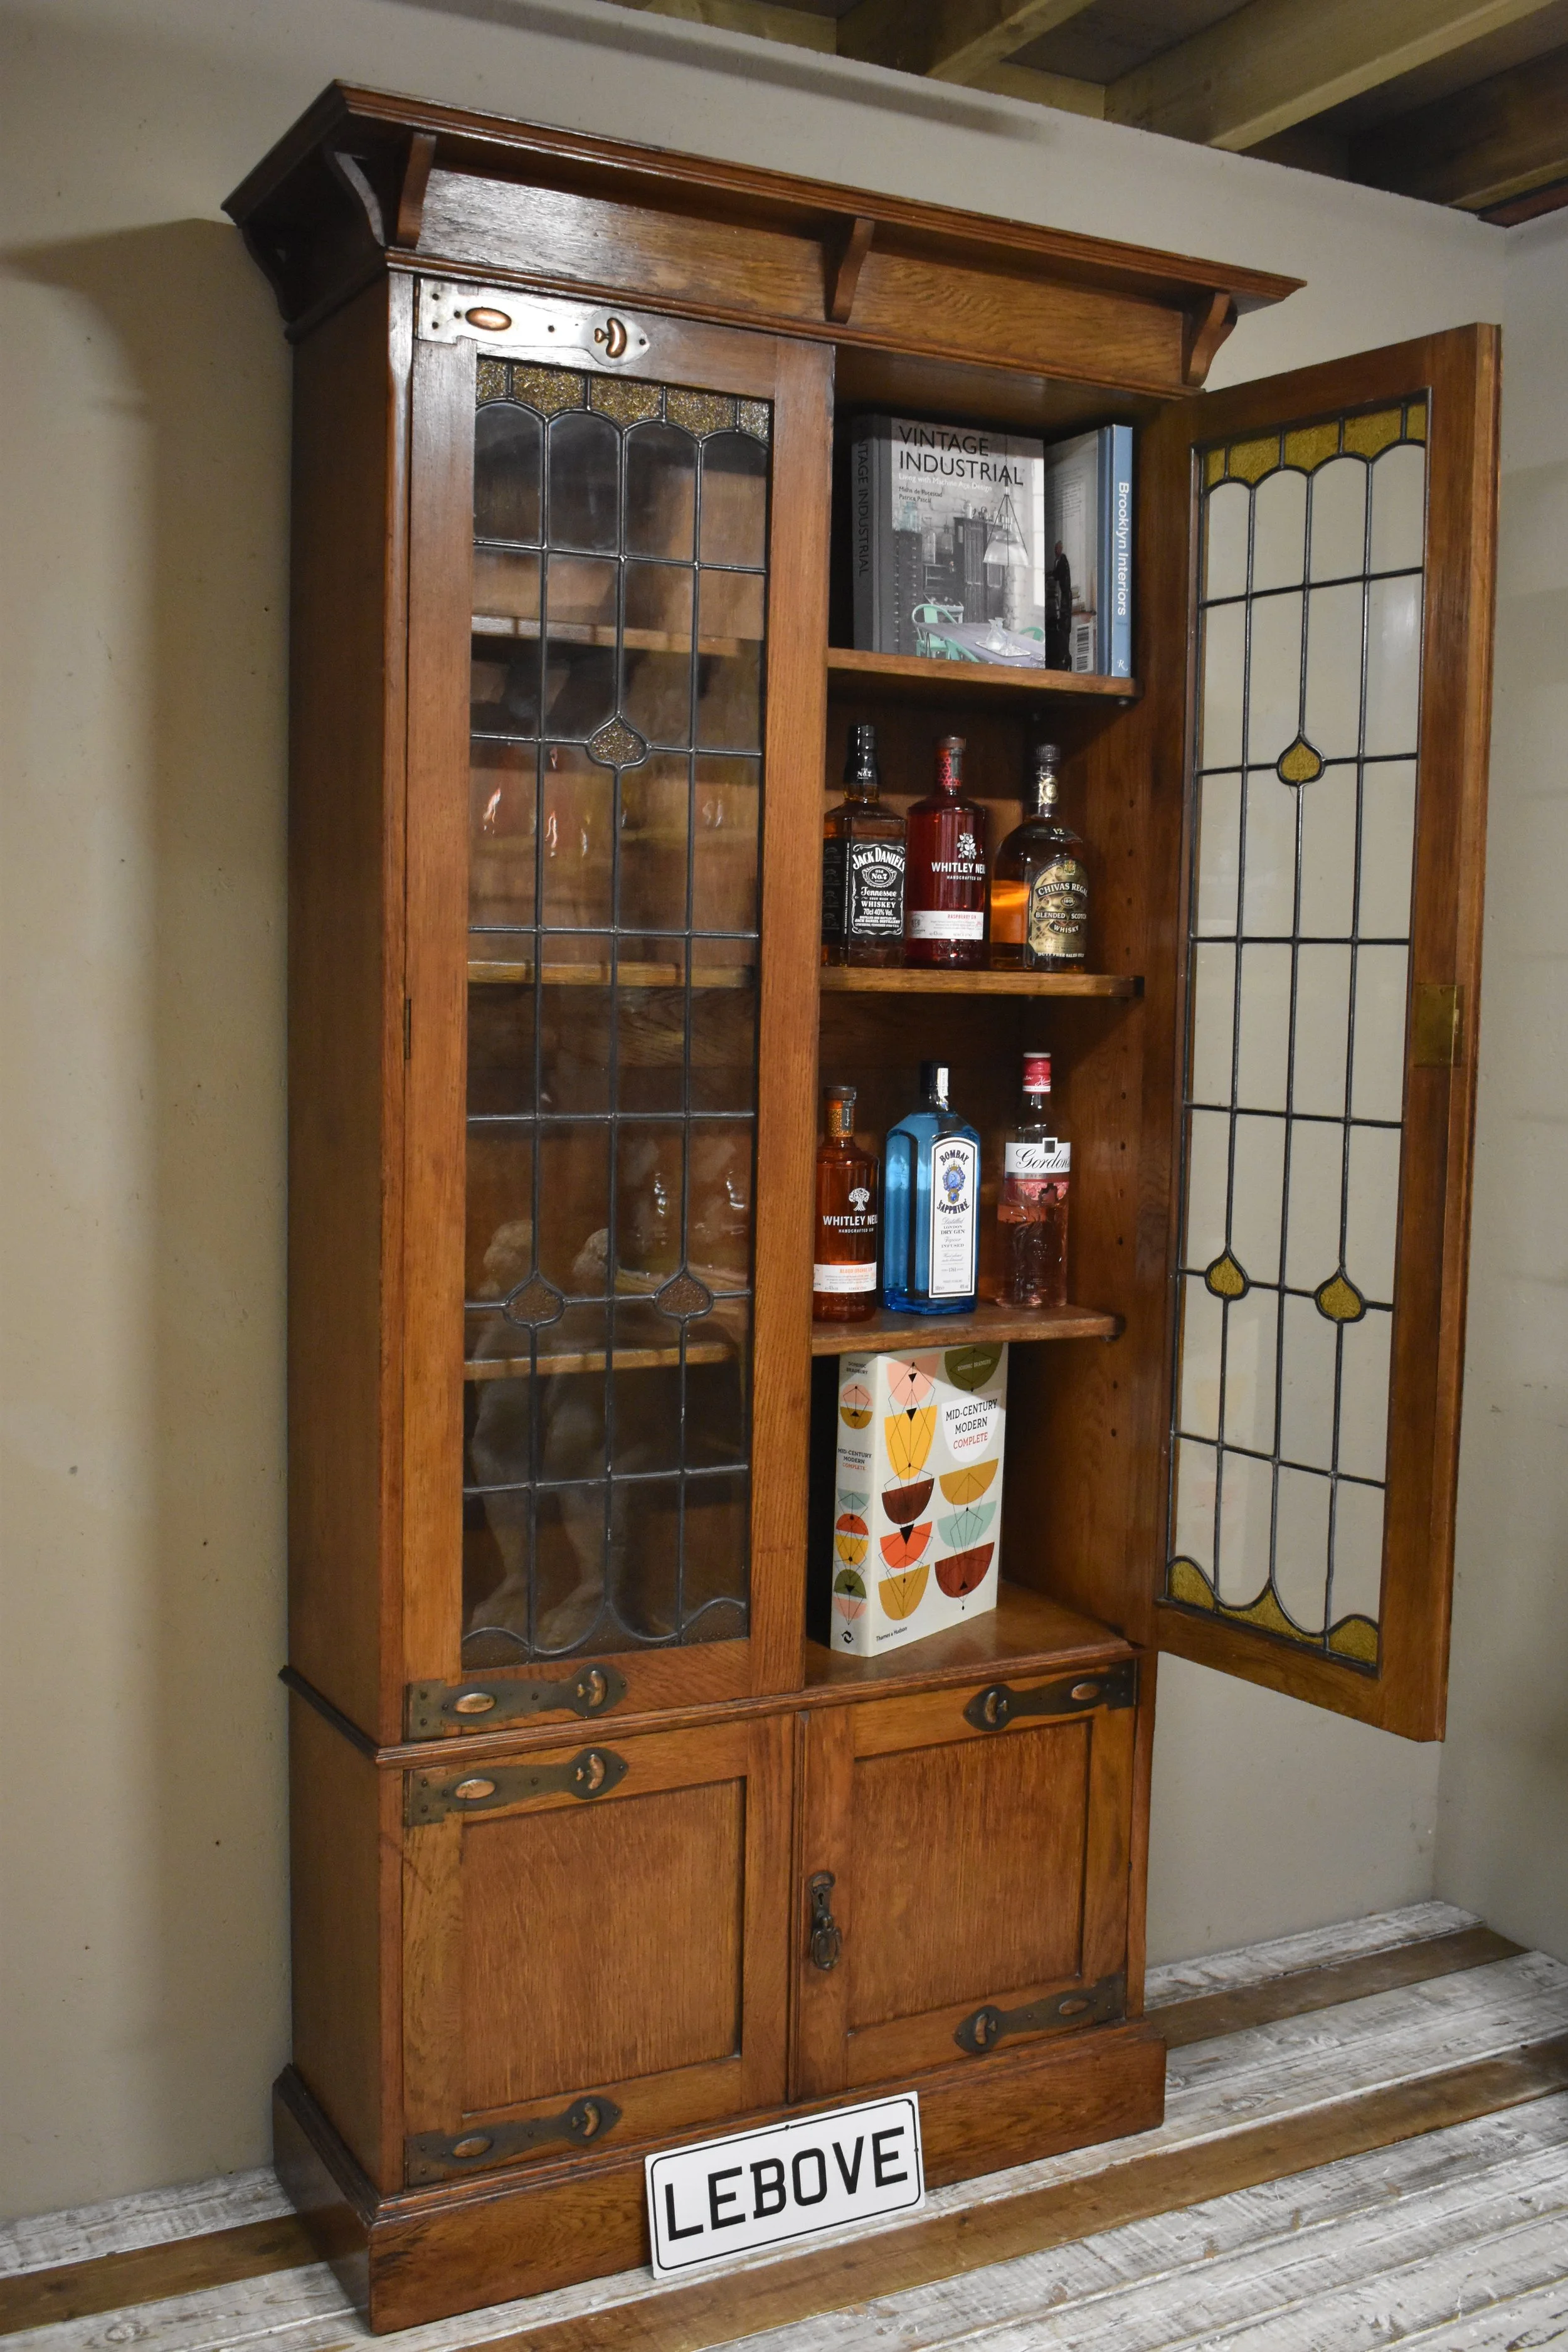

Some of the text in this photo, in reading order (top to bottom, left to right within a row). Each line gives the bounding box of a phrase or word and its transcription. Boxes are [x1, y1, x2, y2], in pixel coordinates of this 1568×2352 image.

[899, 425, 989, 457] VINTAGE
[900, 450, 1024, 486] INDUSTRIAL
[899, 473, 916, 484] Living
[933, 477, 958, 487] Machine
[958, 480, 970, 490] Age
[972, 482, 992, 492] Design
[1116, 482, 1130, 549] Brooklyn
[858, 489, 869, 577] INDUSTRIAL
[1116, 553, 1129, 616] Interiors
[852, 850, 875, 870] JACK
[875, 847, 905, 872] DANIEL'S
[931, 862, 974, 873] WHITLEY
[861, 886, 897, 897] Tennessee
[1038, 882, 1070, 896] CHIVAS
[1054, 924, 1079, 933] WHISKY
[940, 1149, 970, 1166] BOMBAY
[936, 1199, 970, 1214] SAPPHIRE
[822, 1216, 866, 1226] WHITLEY
[946, 1398, 997, 1421] MID-CENTURY
[955, 1416, 988, 1434] MODERN
[953, 1432, 988, 1449] COMPLETE
[838, 1448, 872, 1458] MID-CENTURY
[842, 1463, 866, 1471] COMPLETE
[876, 1633, 890, 1642] Thames
[893, 1626, 908, 1635] Hudson
[665, 2126, 908, 2242] LEBOVE
